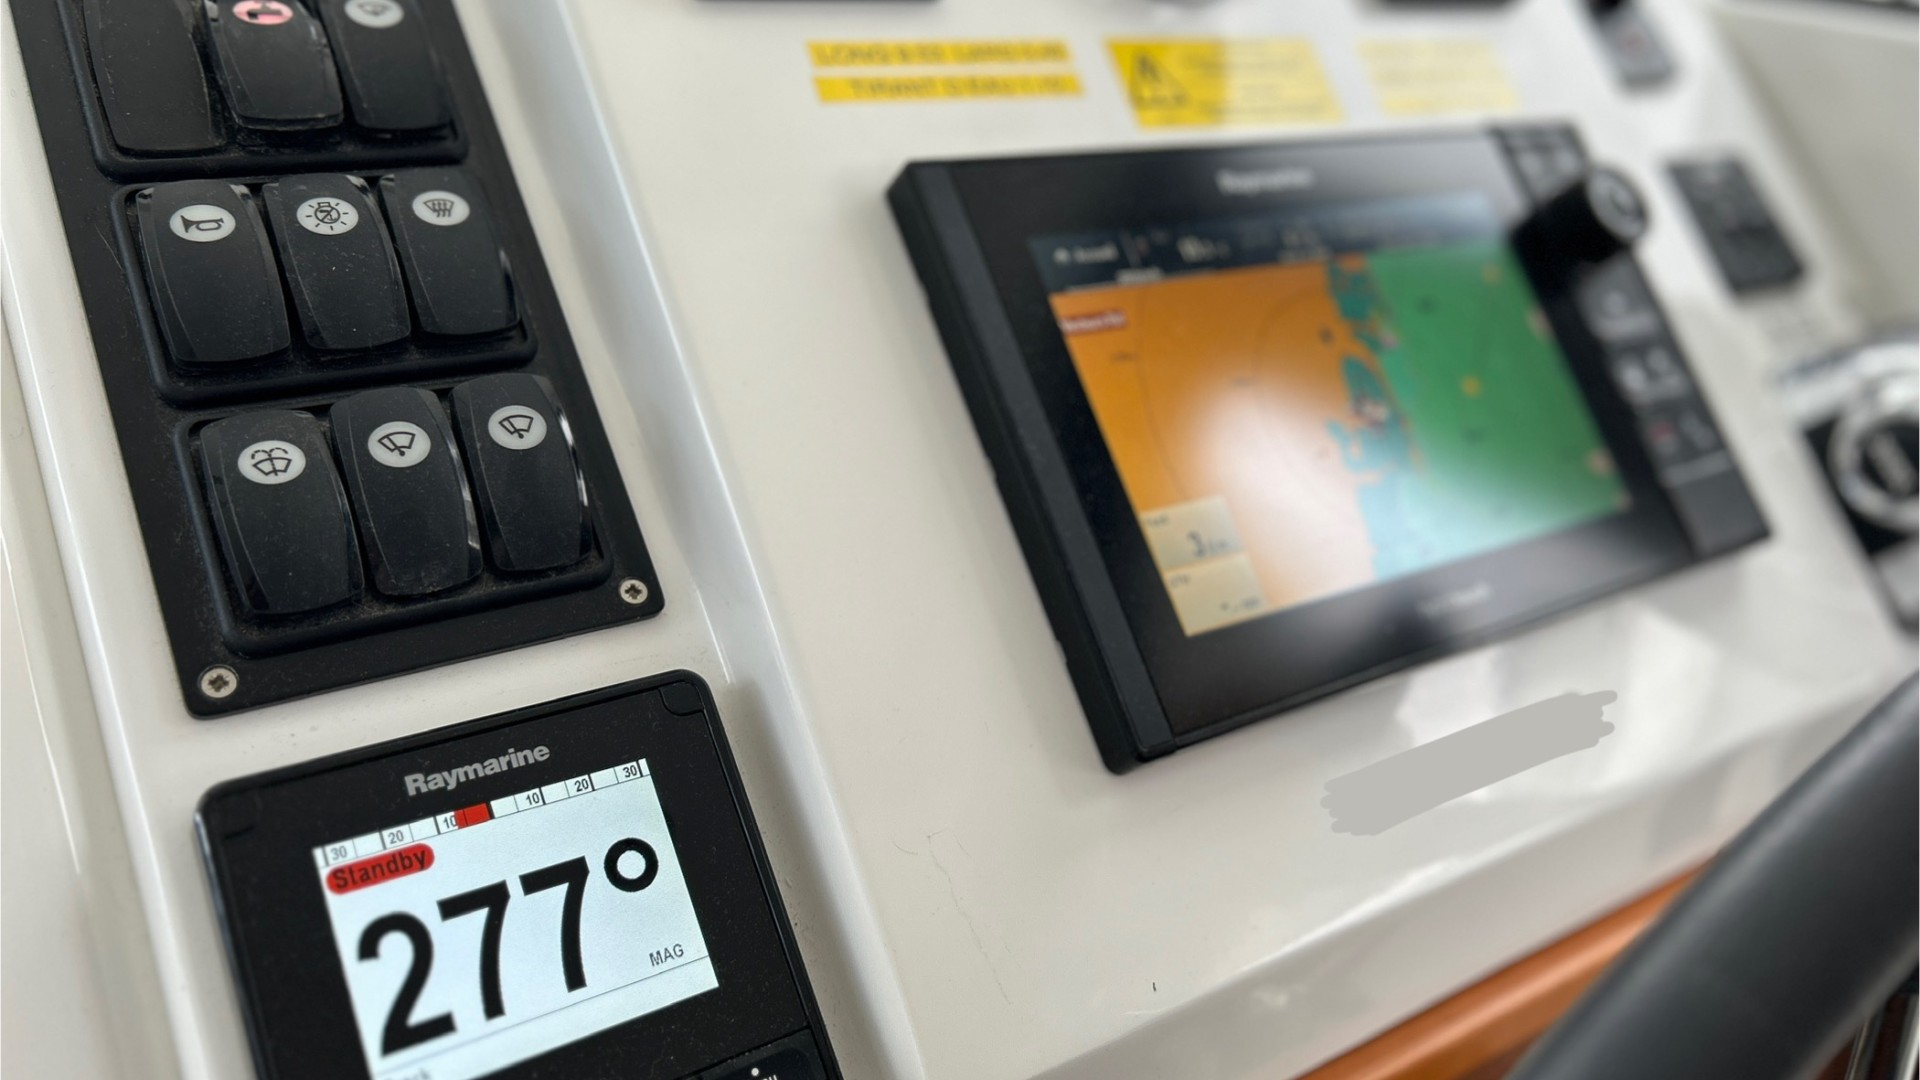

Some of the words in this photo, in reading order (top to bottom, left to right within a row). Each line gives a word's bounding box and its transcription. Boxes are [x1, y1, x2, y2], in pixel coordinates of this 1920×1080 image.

[404, 745, 551, 797] Raymarine
[330, 845, 348, 861] 30
[387, 829, 405, 845] 20
[525, 791, 541, 807] 10
[573, 778, 590, 793] 20
[622, 764, 638, 779] 30
[332, 850, 428, 890] Standby
[649, 943, 685, 967] MAG
